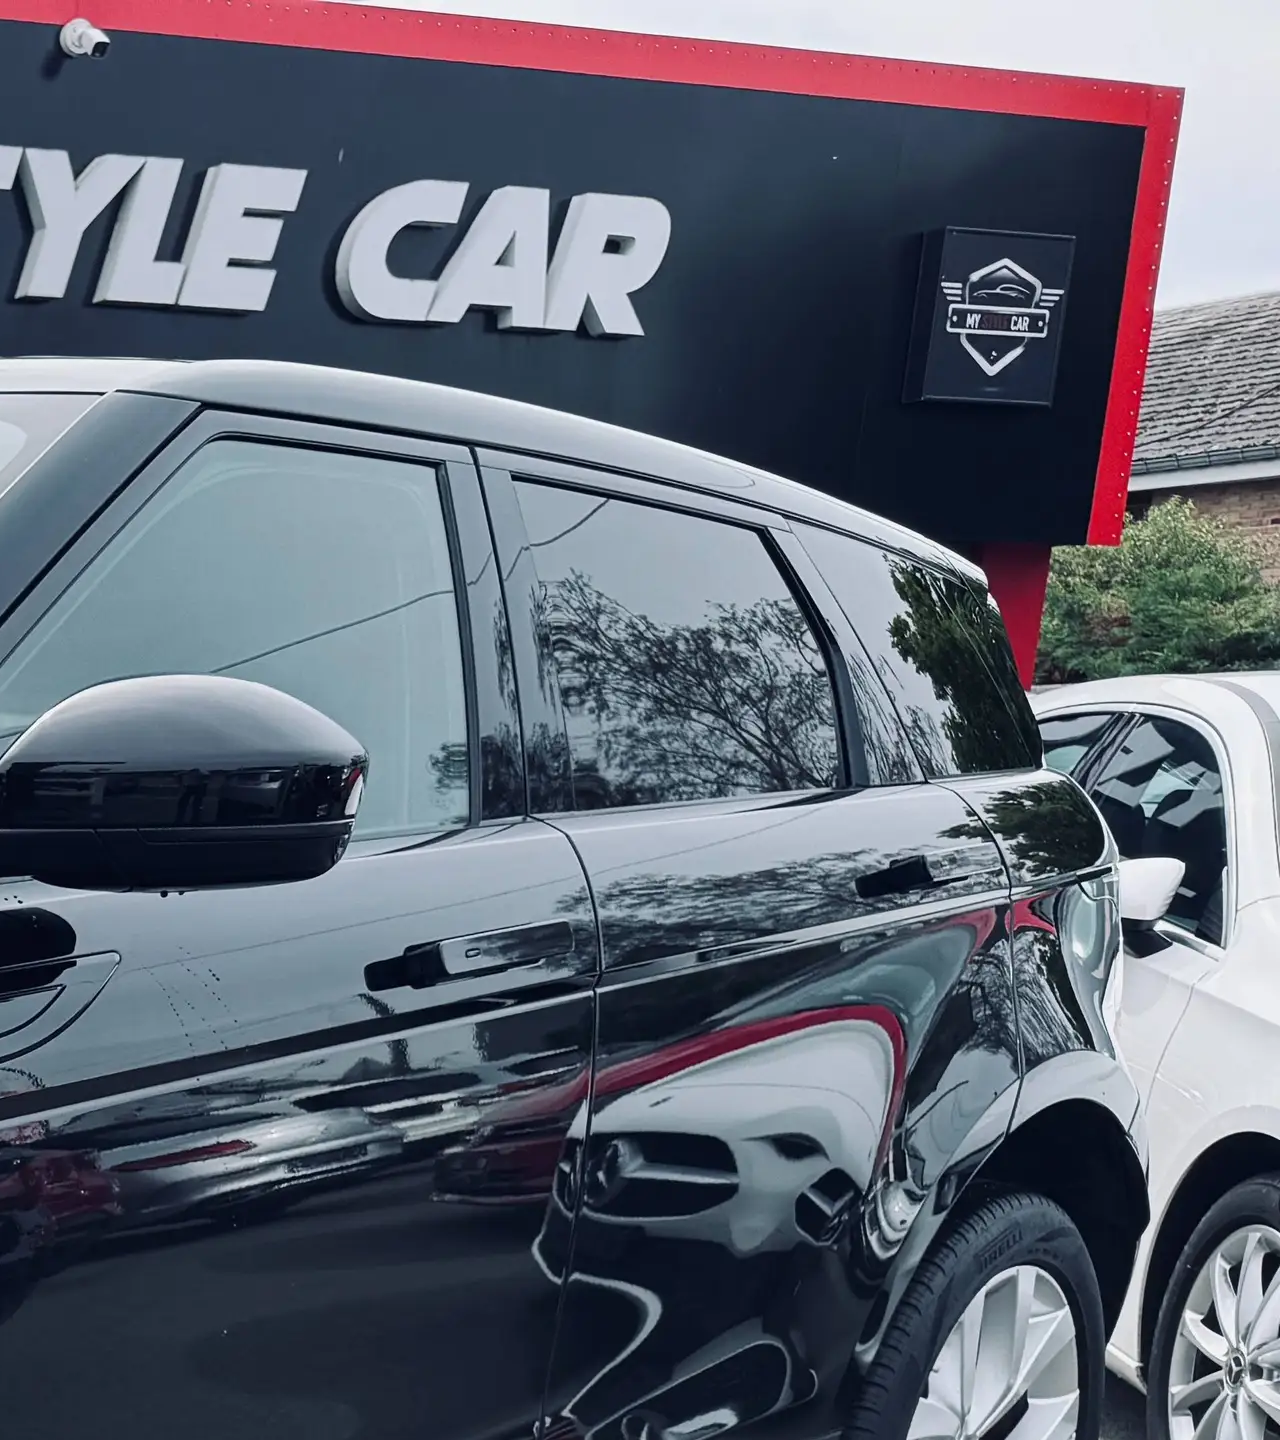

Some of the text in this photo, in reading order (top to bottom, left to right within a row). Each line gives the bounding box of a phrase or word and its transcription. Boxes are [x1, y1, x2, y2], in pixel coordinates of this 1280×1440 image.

[335, 178, 672, 337] CAR
[966, 313, 981, 329] MY
[1010, 315, 1030, 332] CAR
